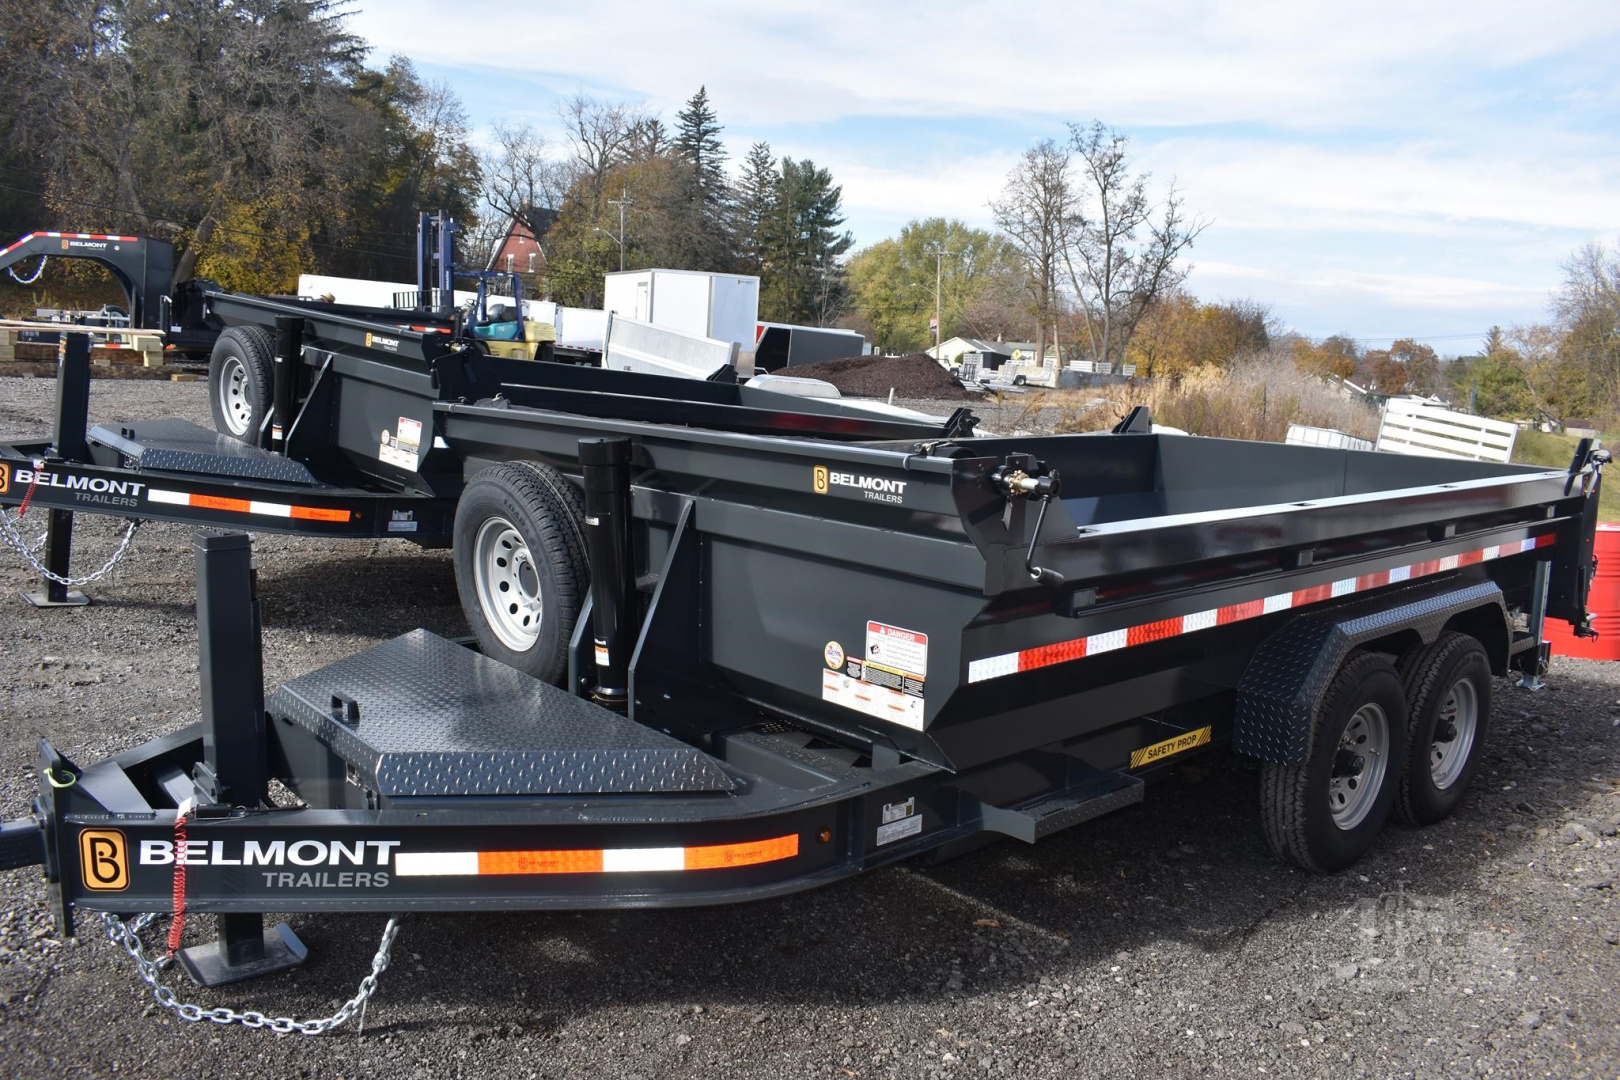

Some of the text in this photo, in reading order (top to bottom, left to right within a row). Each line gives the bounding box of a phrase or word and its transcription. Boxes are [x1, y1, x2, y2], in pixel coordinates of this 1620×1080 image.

[15, 469, 146, 496] BELMONT
[829, 471, 907, 494] BELMONT
[75, 492, 138, 507] TRAILERS
[864, 490, 903, 504] TRAILERS
[887, 628, 915, 642] DANGER
[1148, 735, 1197, 759] SAFETY PROP
[139, 840, 401, 866] BELMONT
[262, 872, 389, 888] TRAILERS
